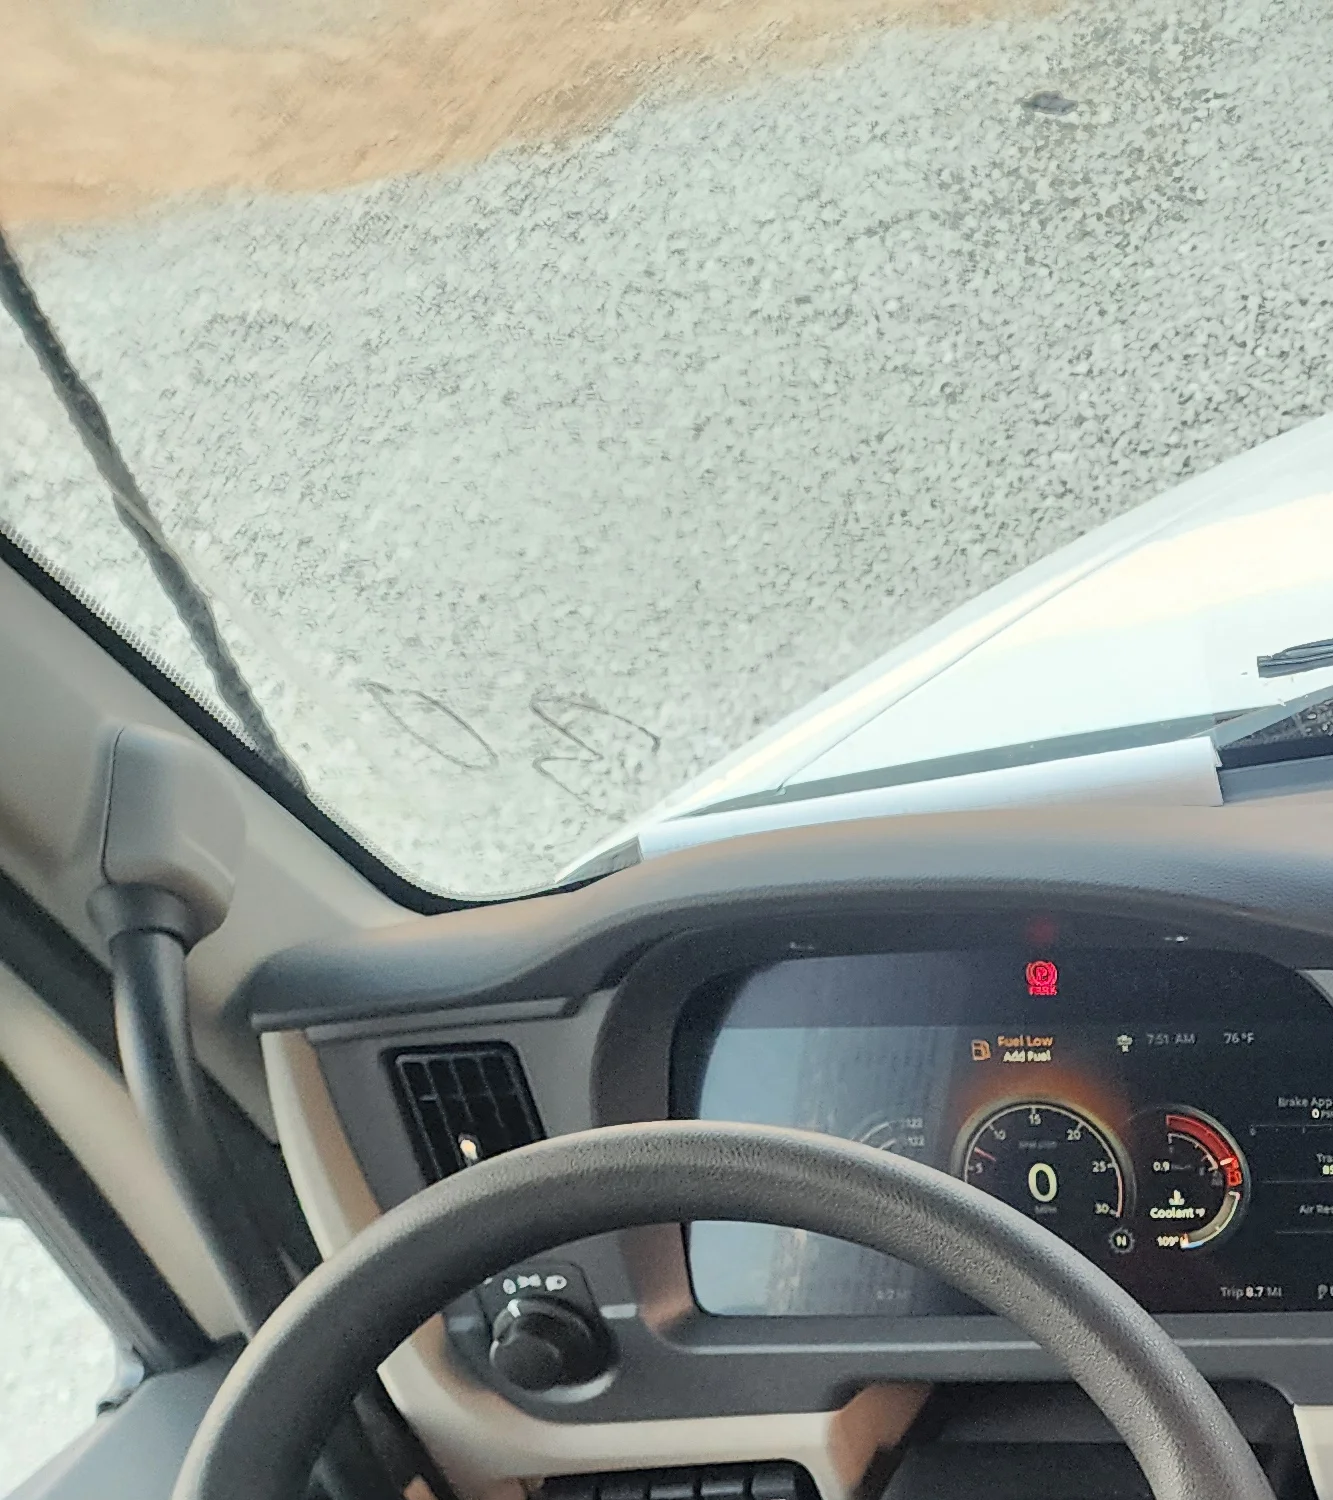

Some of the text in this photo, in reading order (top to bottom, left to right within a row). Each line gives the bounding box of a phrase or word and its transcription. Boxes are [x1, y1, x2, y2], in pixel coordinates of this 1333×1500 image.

[998, 1035, 1053, 1047] Fuel Low
[1312, 1098, 1333, 1110] App
[1092, 1161, 1107, 1172] 25
[1028, 1162, 1058, 1202] 0
[1150, 1207, 1194, 1219] Coolant
[1220, 1286, 1244, 1298] Trip
